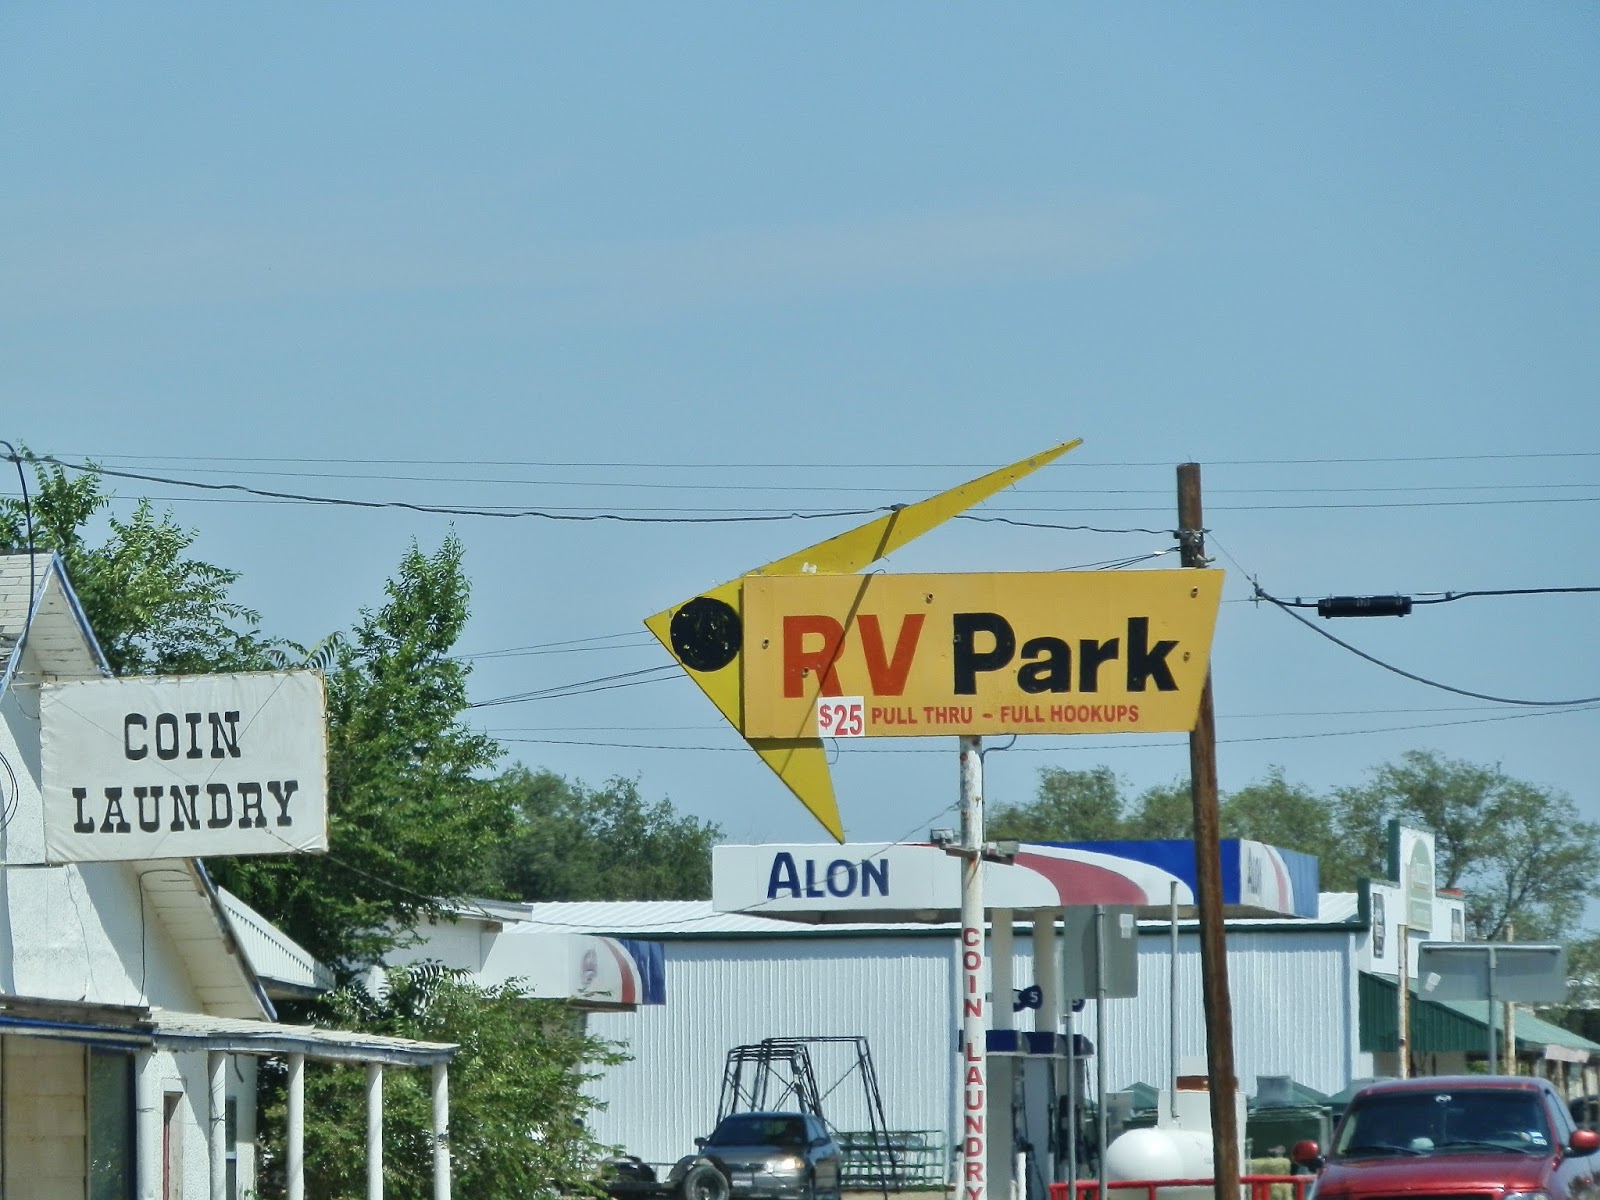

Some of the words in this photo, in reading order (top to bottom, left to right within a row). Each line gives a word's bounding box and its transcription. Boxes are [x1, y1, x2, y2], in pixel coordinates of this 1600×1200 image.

[783, 614, 926, 698] RV
[953, 612, 1179, 695] Park
[124, 711, 241, 760] COIN
[819, 704, 863, 736] $25
[872, 707, 918, 725] PULL
[924, 706, 973, 724] THRU
[1001, 705, 1045, 723] FULL
[1050, 705, 1139, 723] HOOKUPS
[72, 780, 298, 833] LAUNDRY
[766, 851, 889, 899] ALON
[963, 927, 982, 1018] COIN
[1030, 991, 1039, 1003] 5
[966, 1042, 984, 1200] LAUNDRY
